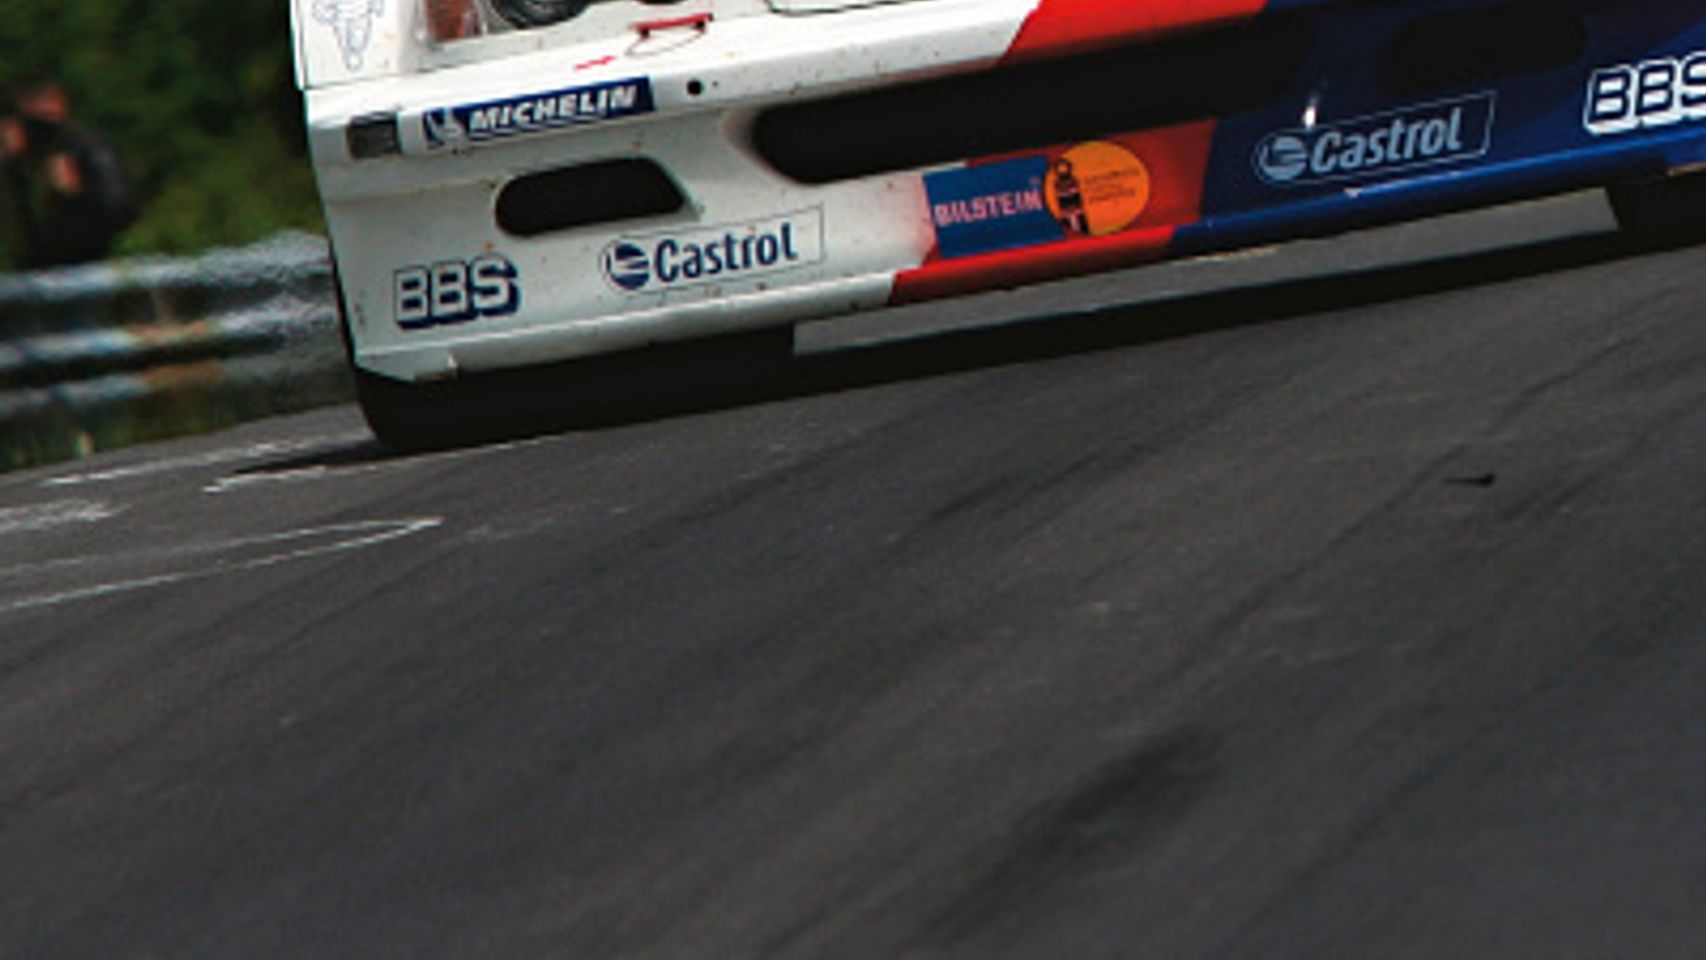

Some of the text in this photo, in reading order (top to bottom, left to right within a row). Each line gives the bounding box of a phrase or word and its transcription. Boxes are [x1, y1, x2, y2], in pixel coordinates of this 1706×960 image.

[469, 84, 638, 132] MICHELIN
[1310, 107, 1462, 173] Castrol
[934, 188, 1043, 227] BILSTEIN
[655, 224, 797, 281] Castrol
[394, 254, 521, 328] BBS
